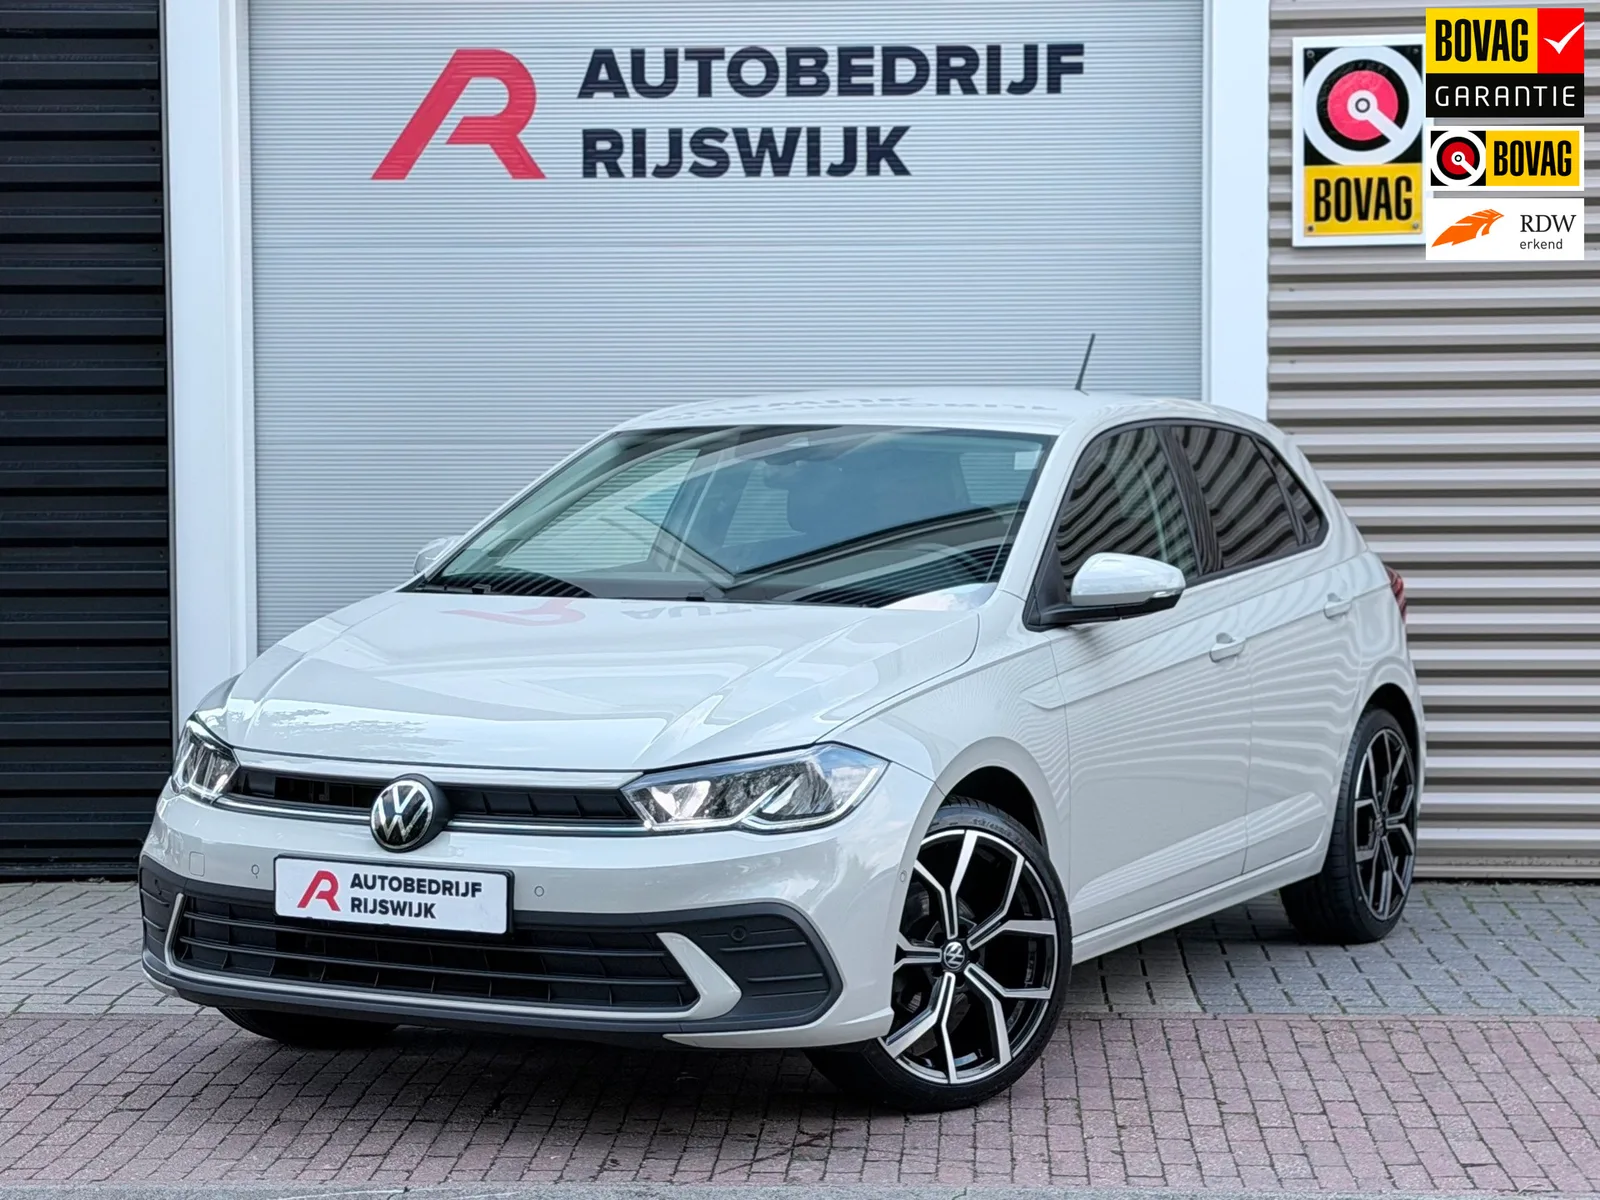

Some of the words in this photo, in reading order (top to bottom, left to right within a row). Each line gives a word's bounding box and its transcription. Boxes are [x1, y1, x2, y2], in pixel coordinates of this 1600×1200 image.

[578, 43, 1084, 99] AUTOBEDRIJF
[582, 126, 911, 179] RIJSWIJK
[1314, 175, 1413, 223] BOVAG
[350, 873, 482, 898] AUTOBEDRIJF
[350, 896, 437, 919] RIJSWIJK
